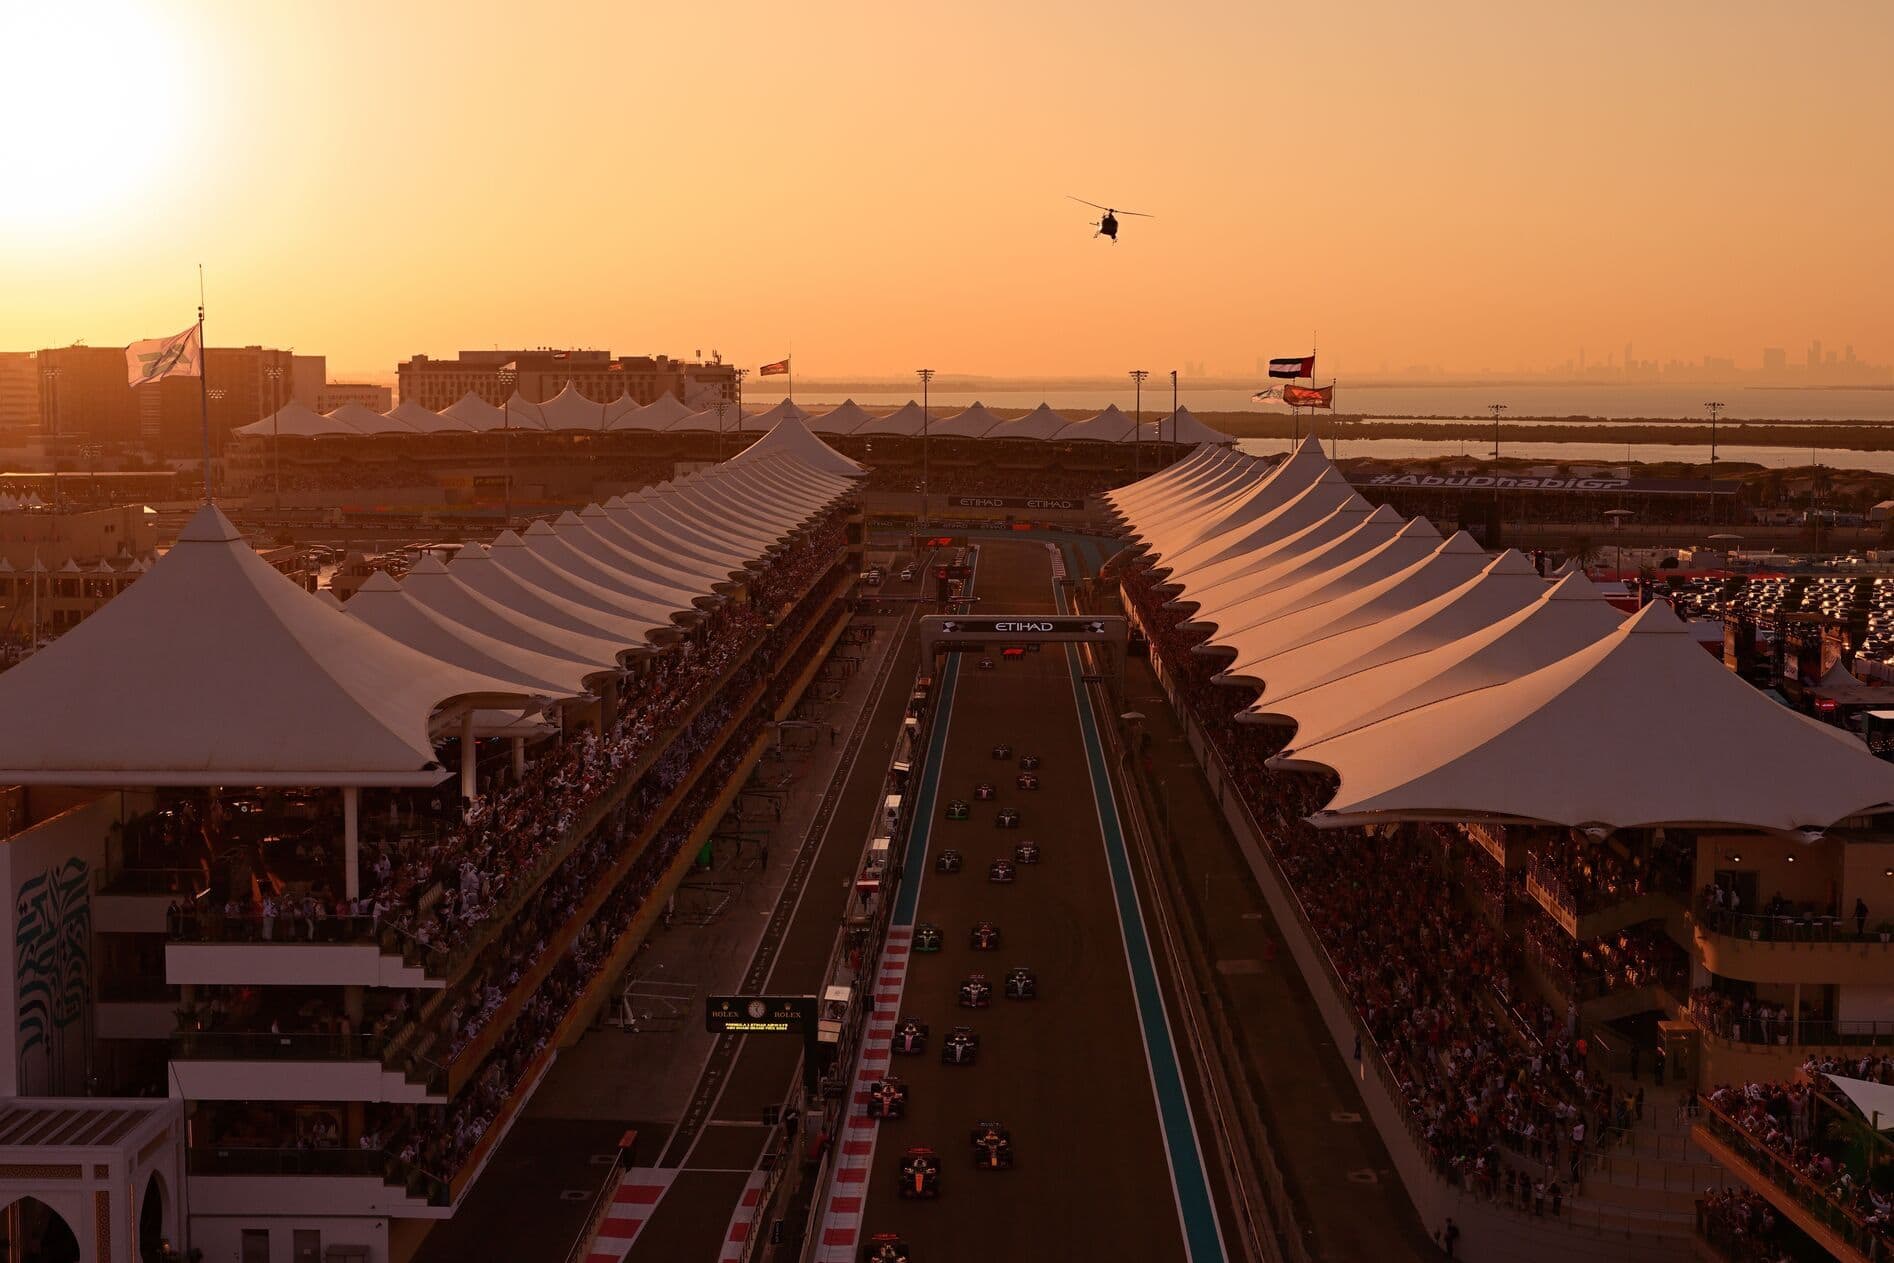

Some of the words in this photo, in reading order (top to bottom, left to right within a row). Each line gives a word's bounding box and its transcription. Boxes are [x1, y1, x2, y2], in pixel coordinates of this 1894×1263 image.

[1370, 474, 1630, 489] #AbuDhabiGP
[960, 497, 1003, 506] ETIHAD
[1026, 499, 1071, 509] ETIHAD
[995, 622, 1054, 632] ETIHAD
